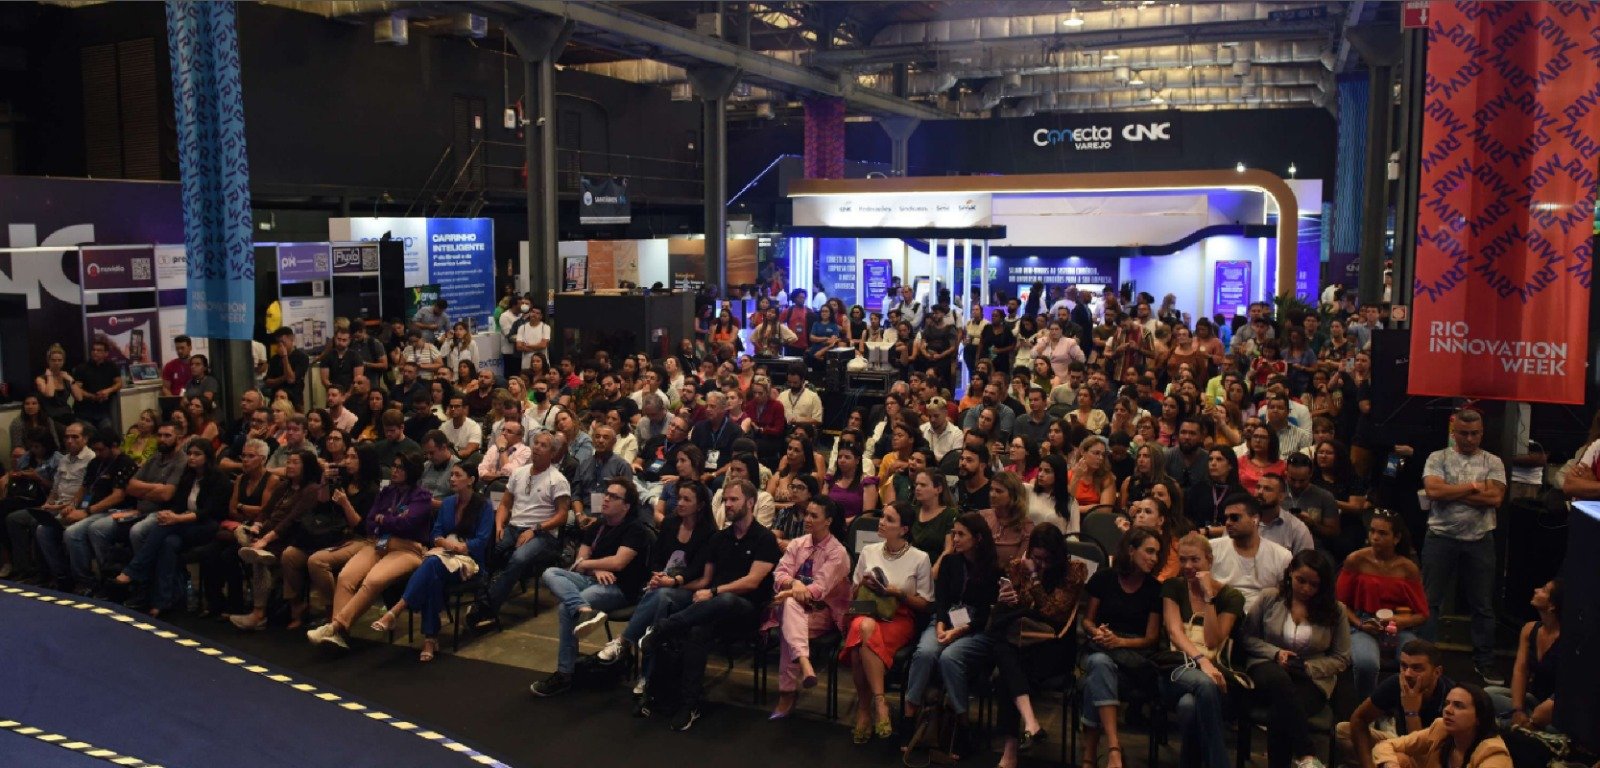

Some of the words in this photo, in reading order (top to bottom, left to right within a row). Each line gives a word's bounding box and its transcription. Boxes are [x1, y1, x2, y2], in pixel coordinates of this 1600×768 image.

[1122, 122, 1171, 141] CNC
[1075, 142, 1111, 150] VAREJO
[432, 234, 476, 242] CARRINHO
[433, 243, 485, 252] INTELIGENTE
[1430, 321, 1469, 337] RIO
[1429, 337, 1567, 359] INNOVATION
[1501, 358, 1566, 376] WEEK
